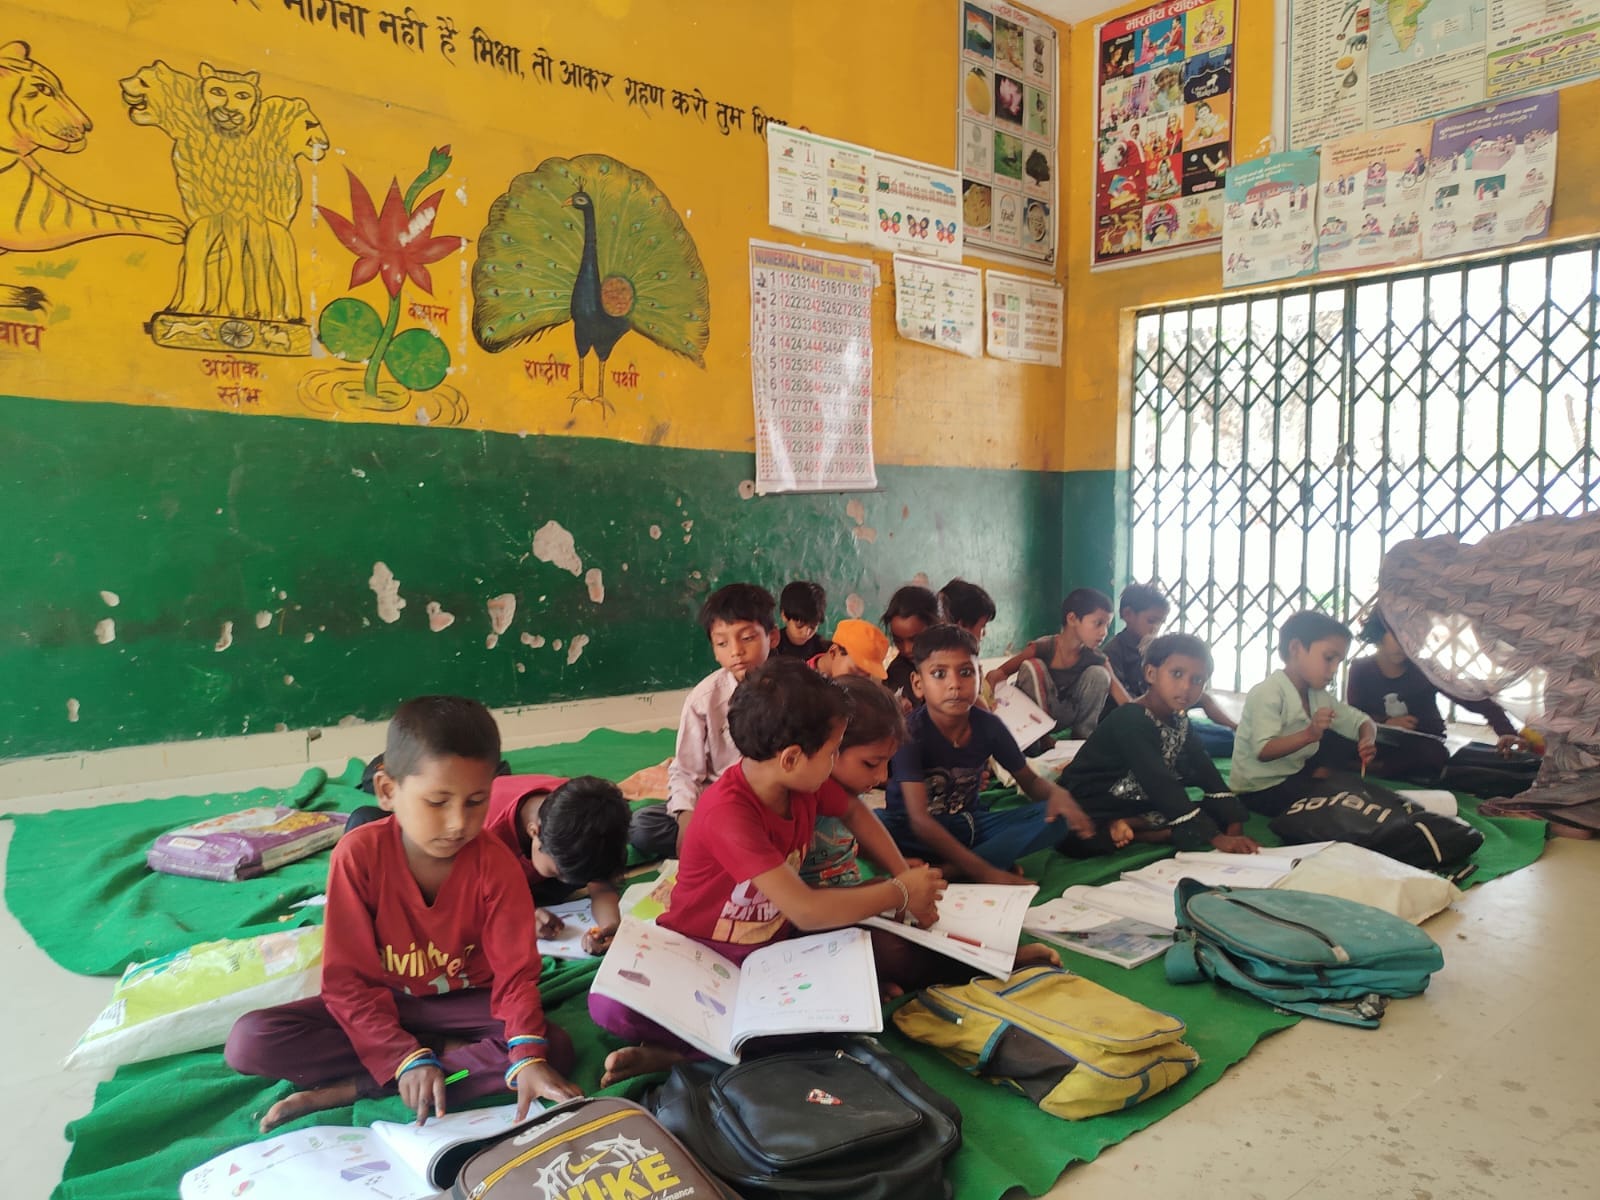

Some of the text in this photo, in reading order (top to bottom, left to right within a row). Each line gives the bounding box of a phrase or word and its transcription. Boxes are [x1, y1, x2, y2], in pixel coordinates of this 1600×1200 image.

[436, 16, 459, 67] है
[532, 47, 554, 85] तो
[559, 60, 614, 102] आकर
[624, 77, 666, 120] ग्रहण
[672, 88, 709, 125] करो
[715, 101, 745, 136] तुम
